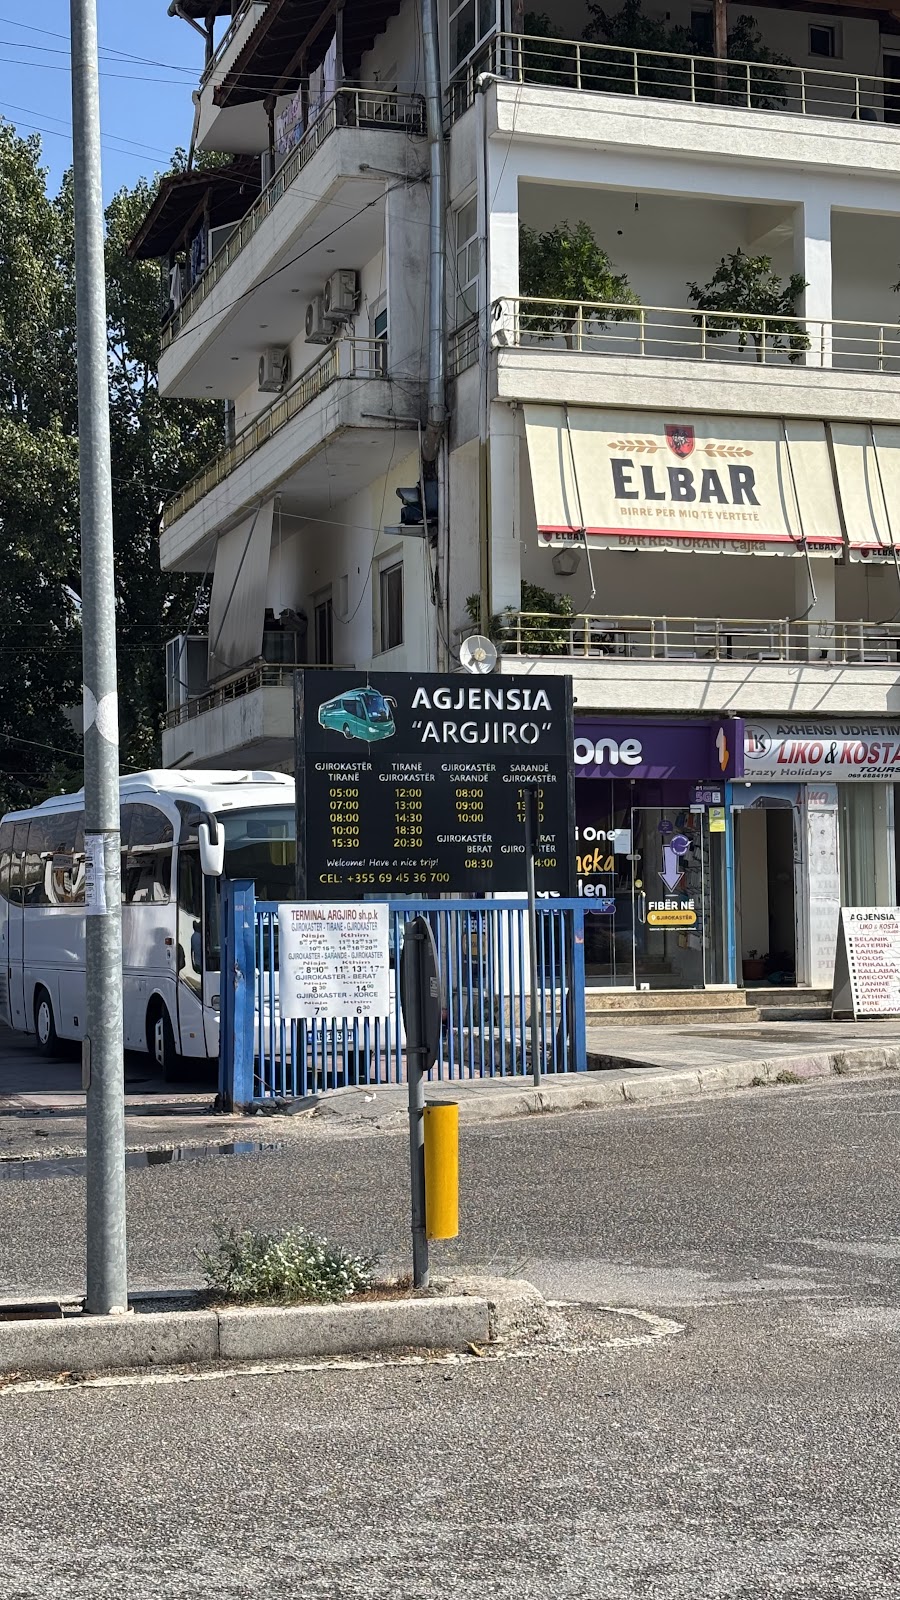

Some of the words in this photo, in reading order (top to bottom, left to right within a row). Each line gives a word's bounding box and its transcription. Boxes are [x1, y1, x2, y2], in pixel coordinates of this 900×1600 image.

[610, 458, 761, 506] ELBAR
[620, 505, 653, 516] BIRRË
[656, 507, 676, 518] PËR
[679, 510, 699, 519] MIQ
[702, 509, 714, 519] TË
[716, 509, 759, 522] VËRTETË
[619, 535, 646, 546] BAR
[650, 536, 727, 549] RESTORANT
[731, 540, 766, 553] Çajka
[411, 687, 552, 711] AGJENSIA
[776, 724, 837, 736] AXHENSI
[574, 737, 643, 766] one
[777, 742, 823, 765] LIKO
[824, 741, 838, 764] &
[315, 762, 372, 771] GJIROKASTËR
[392, 762, 422, 771] TIRANË
[441, 762, 496, 772] GJIROKASTËR
[510, 763, 549, 772] SARANDË
[328, 772, 360, 781] TIRANË
[379, 773, 436, 781] GJIROKASTËR
[450, 773, 488, 782] SARANDË
[502, 773, 557, 782] GJIROKASTËR
[744, 769, 777, 777] Crazy
[781, 768, 833, 778] Holidays
[329, 788, 359, 798] 05:00
[395, 788, 422, 797] 12:00
[455, 788, 484, 798] 08:00
[695, 791, 711, 803] 5G
[329, 801, 359, 810] 07:00
[395, 801, 422, 810] 13:00
[455, 801, 484, 810] 09:00
[516, 801, 544, 810] 130
[329, 813, 359, 822] 08:00
[395, 813, 422, 822] 14:30
[457, 813, 484, 822] 10:00
[516, 813, 544, 822] 170
[332, 826, 359, 835] 10:00
[396, 826, 423, 835] 18:30
[583, 827, 615, 841] One
[436, 833, 492, 842] GJIROKASTËR
[540, 834, 556, 842] RAT
[332, 838, 360, 848] 15:30
[393, 838, 423, 847] 20:30
[467, 845, 492, 853] BERAT
[500, 845, 556, 853] GJIROTËR
[327, 858, 365, 867] Welcome!
[369, 858, 389, 867] Have
[401, 858, 417, 867] nice
[420, 857, 439, 869] trip!
[464, 859, 494, 868] 08:30
[534, 859, 557, 868] 4:00
[319, 873, 343, 883] CEL:
[347, 873, 375, 882] +355
[379, 873, 392, 882] 69
[395, 873, 409, 882] 45
[413, 873, 427, 882] 36
[430, 873, 450, 882] 700
[576, 879, 607, 897] len
[648, 899, 678, 911] FIBËR
[680, 899, 695, 910] NË
[291, 910, 326, 920] TERMINAL
[327, 909, 357, 920] ARGJIRO
[358, 909, 378, 921] sh.p.k
[850, 913, 895, 921] AGJENSIA
[326, 922, 343, 931] TIRANE
